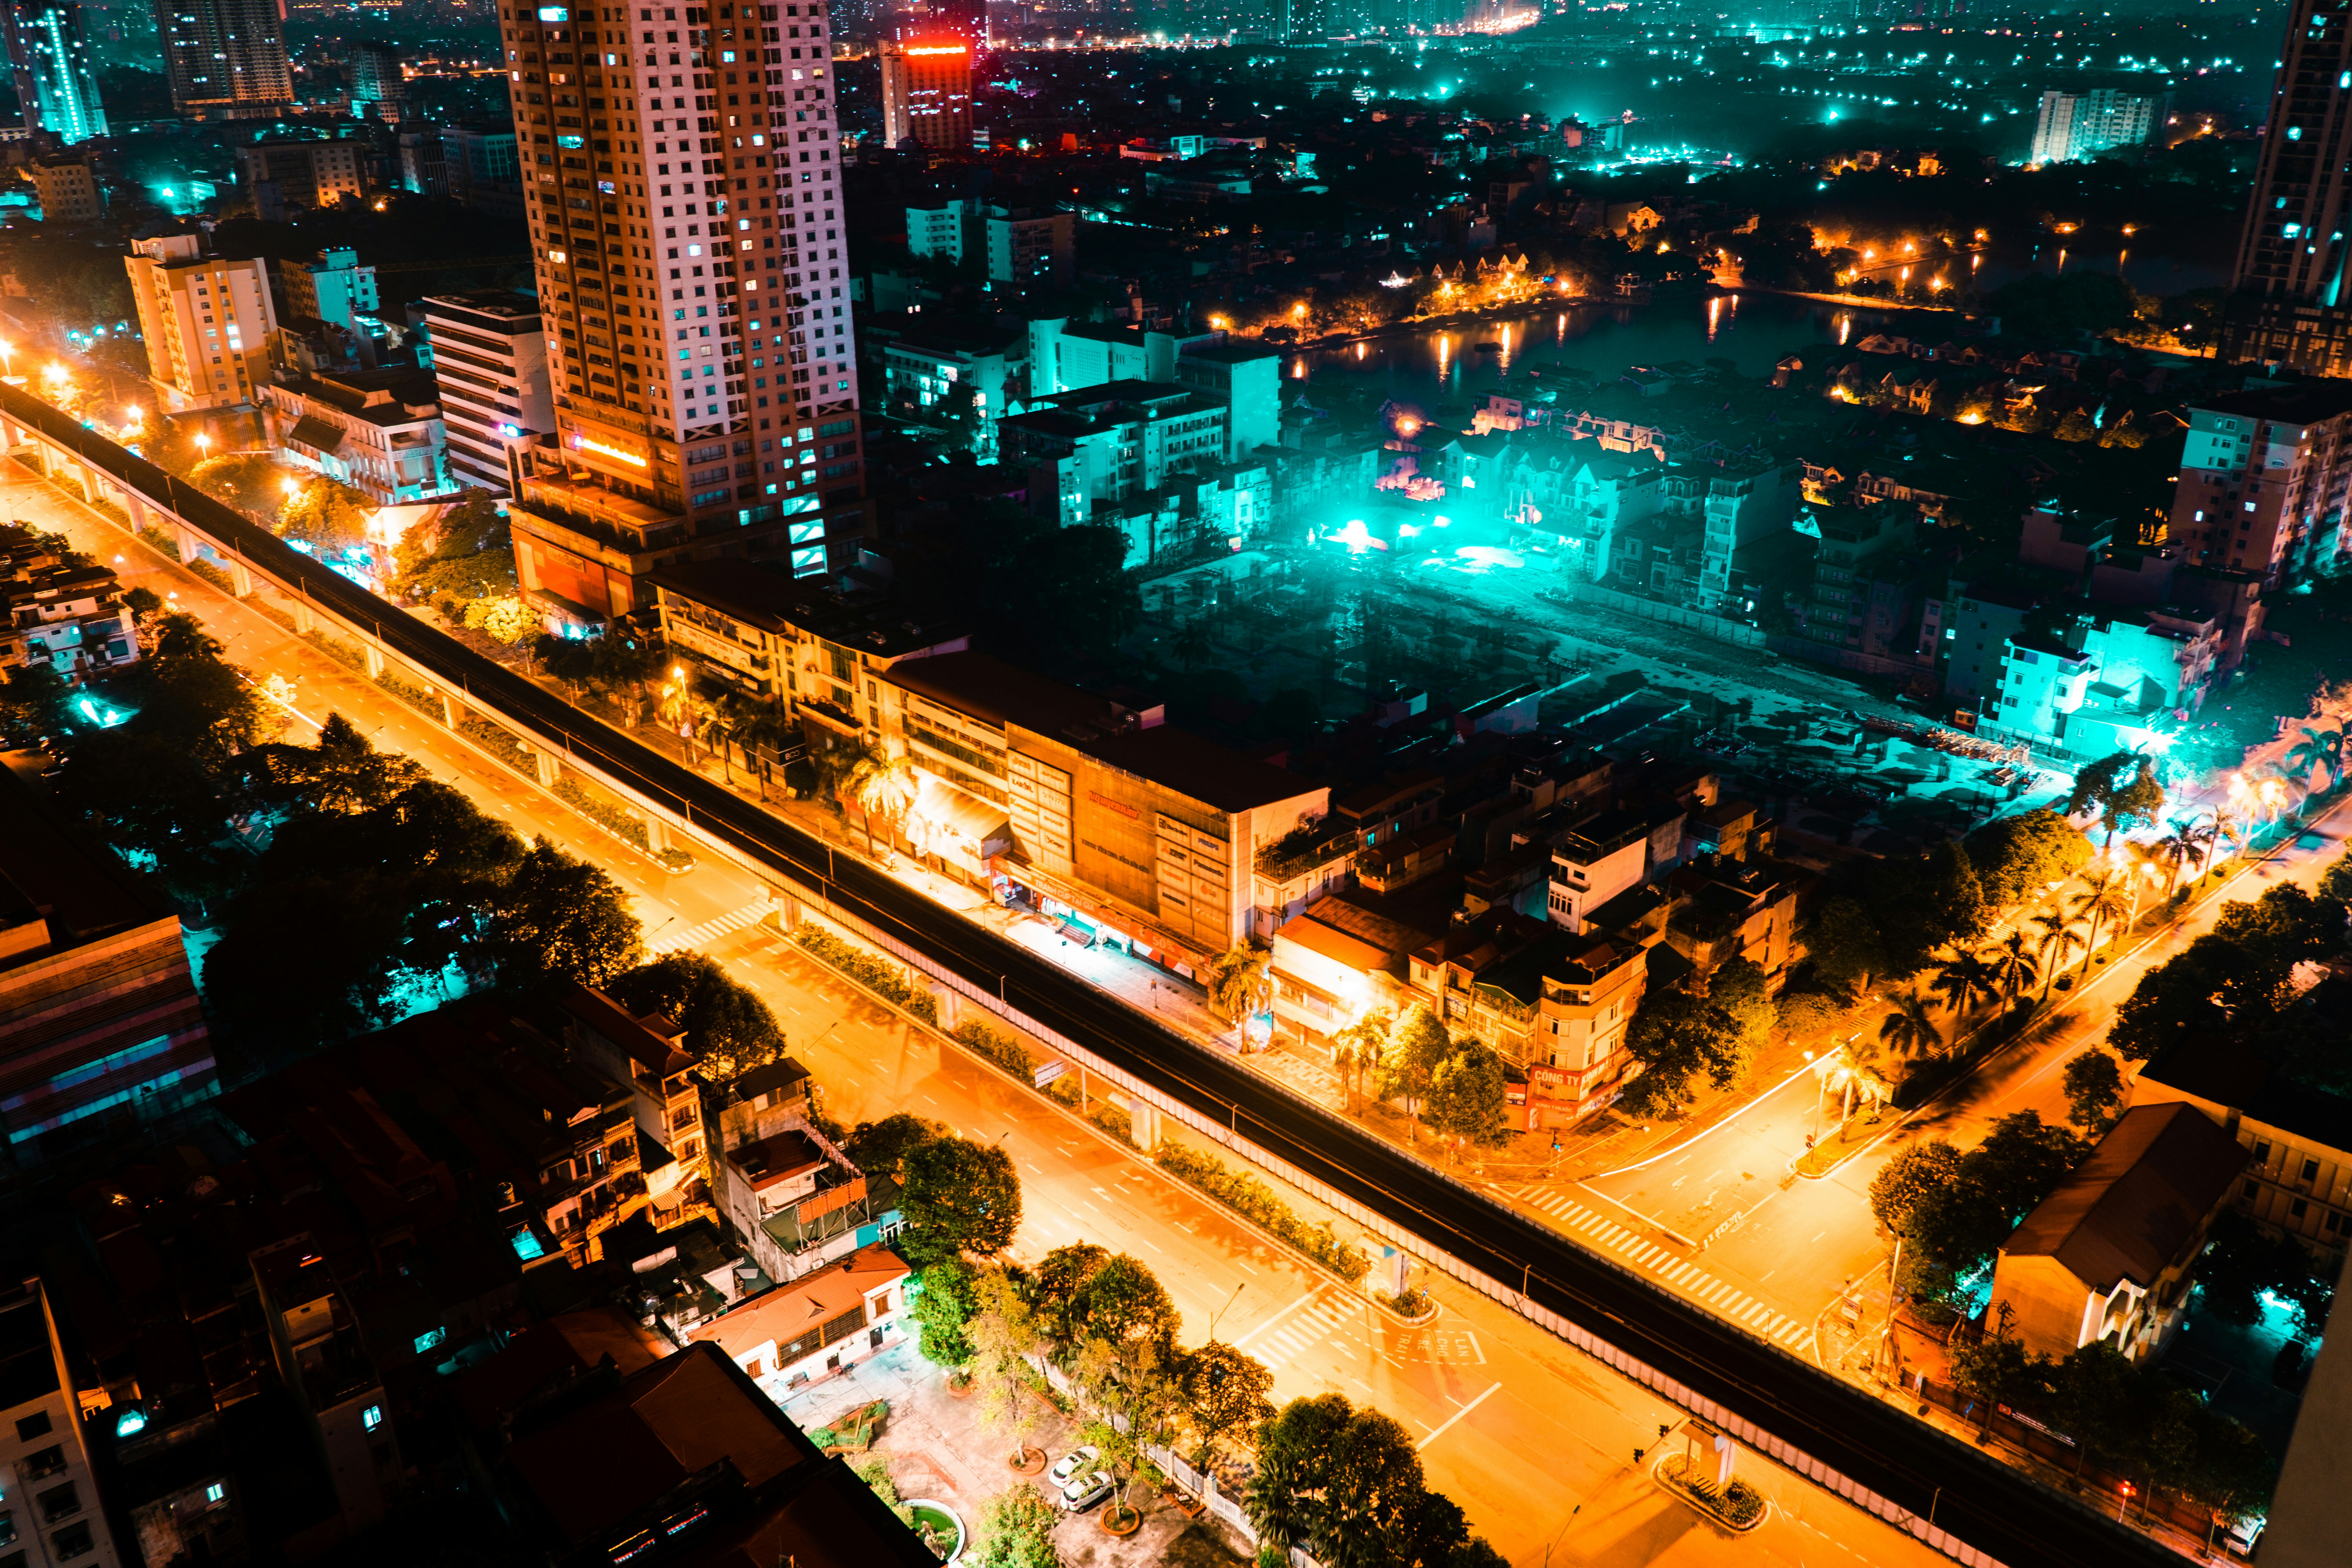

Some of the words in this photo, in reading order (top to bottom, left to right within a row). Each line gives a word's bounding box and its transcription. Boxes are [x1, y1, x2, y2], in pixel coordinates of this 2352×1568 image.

[1152, 936, 1175, 953] 50%
[1534, 1069, 1563, 1084] CÔNG
[1566, 1075, 1580, 1087] TY
